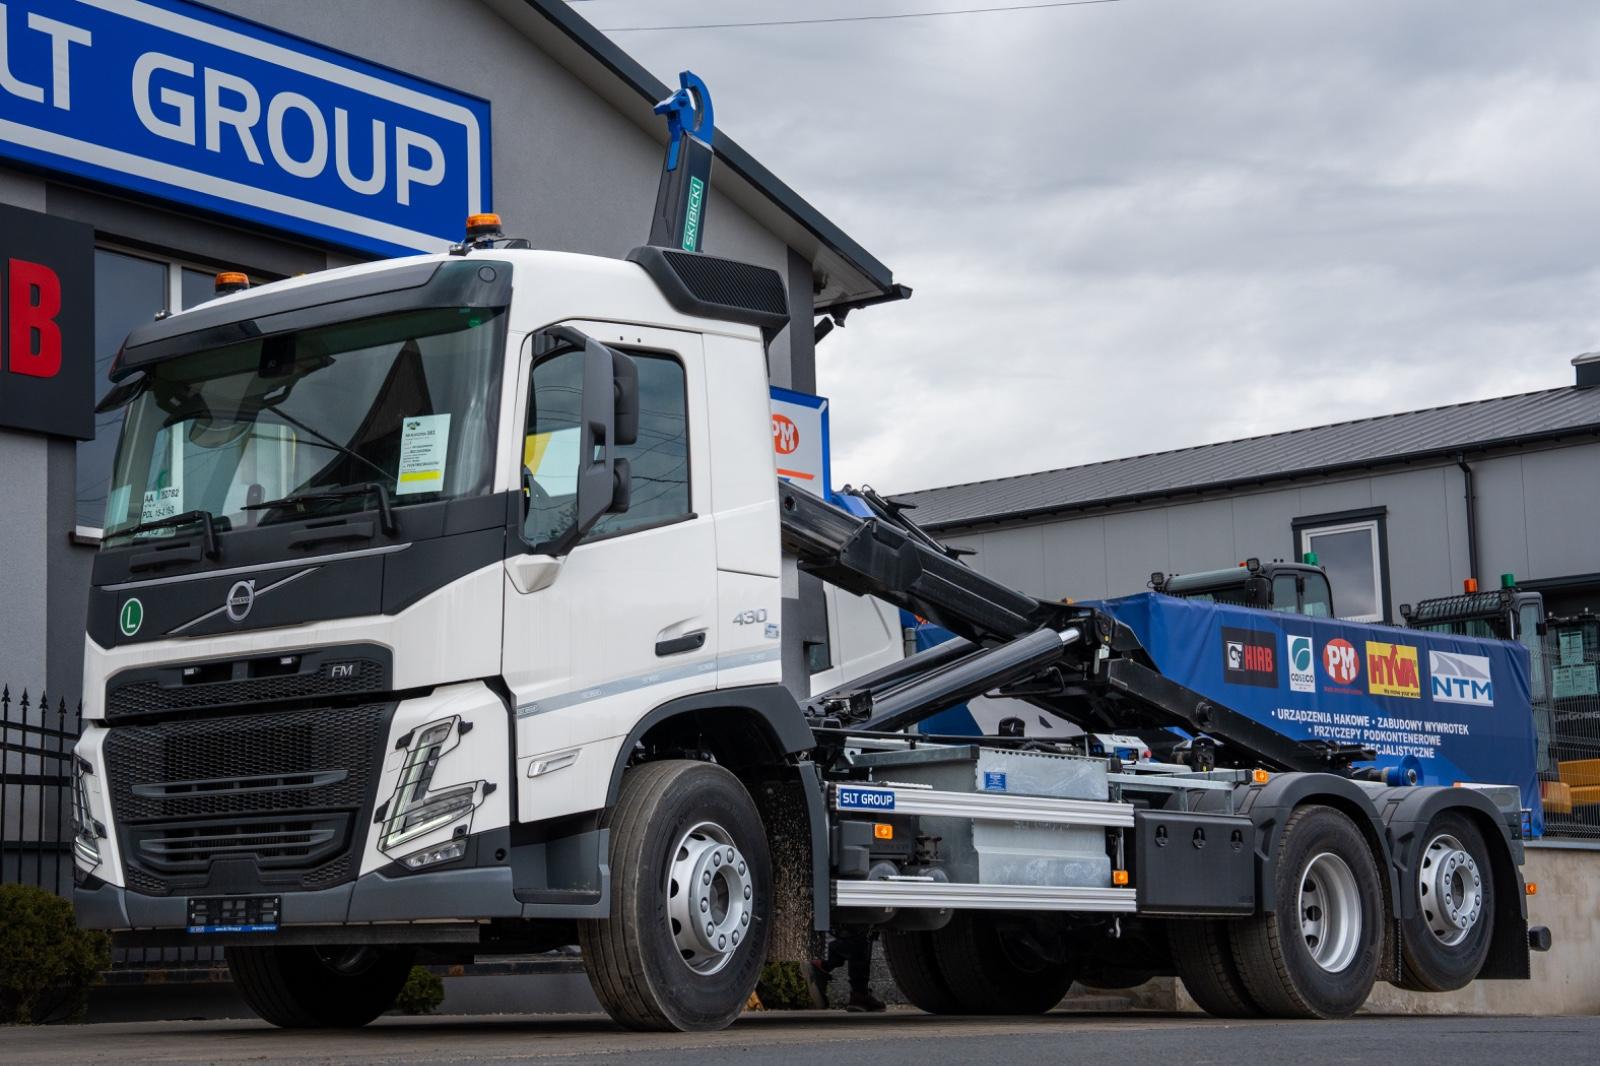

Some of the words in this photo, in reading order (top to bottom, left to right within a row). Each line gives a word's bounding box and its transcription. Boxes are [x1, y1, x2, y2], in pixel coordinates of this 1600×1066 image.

[132, 52, 446, 207] GROUP
[685, 183, 701, 247] SKIBICKI
[0, 257, 62, 379] B
[126, 606, 136, 628] L
[732, 608, 768, 625] 430
[331, 664, 354, 678] FM
[1244, 645, 1273, 673] HIAB
[1326, 644, 1357, 681] PM
[1368, 646, 1419, 689] HYVA
[1431, 676, 1493, 701] NTM
[1277, 708, 1332, 724] URZĄDZENIA
[1333, 713, 1370, 727] HAKOWE
[1377, 717, 1422, 730] ZABUDOWY
[1424, 721, 1470, 735] WYWROTEK
[1314, 725, 1361, 740] PRZYCZEPY
[1364, 730, 1441, 746] PODKONTENEROWE
[842, 792, 858, 804] SLT
[861, 793, 893, 806] GROUP
